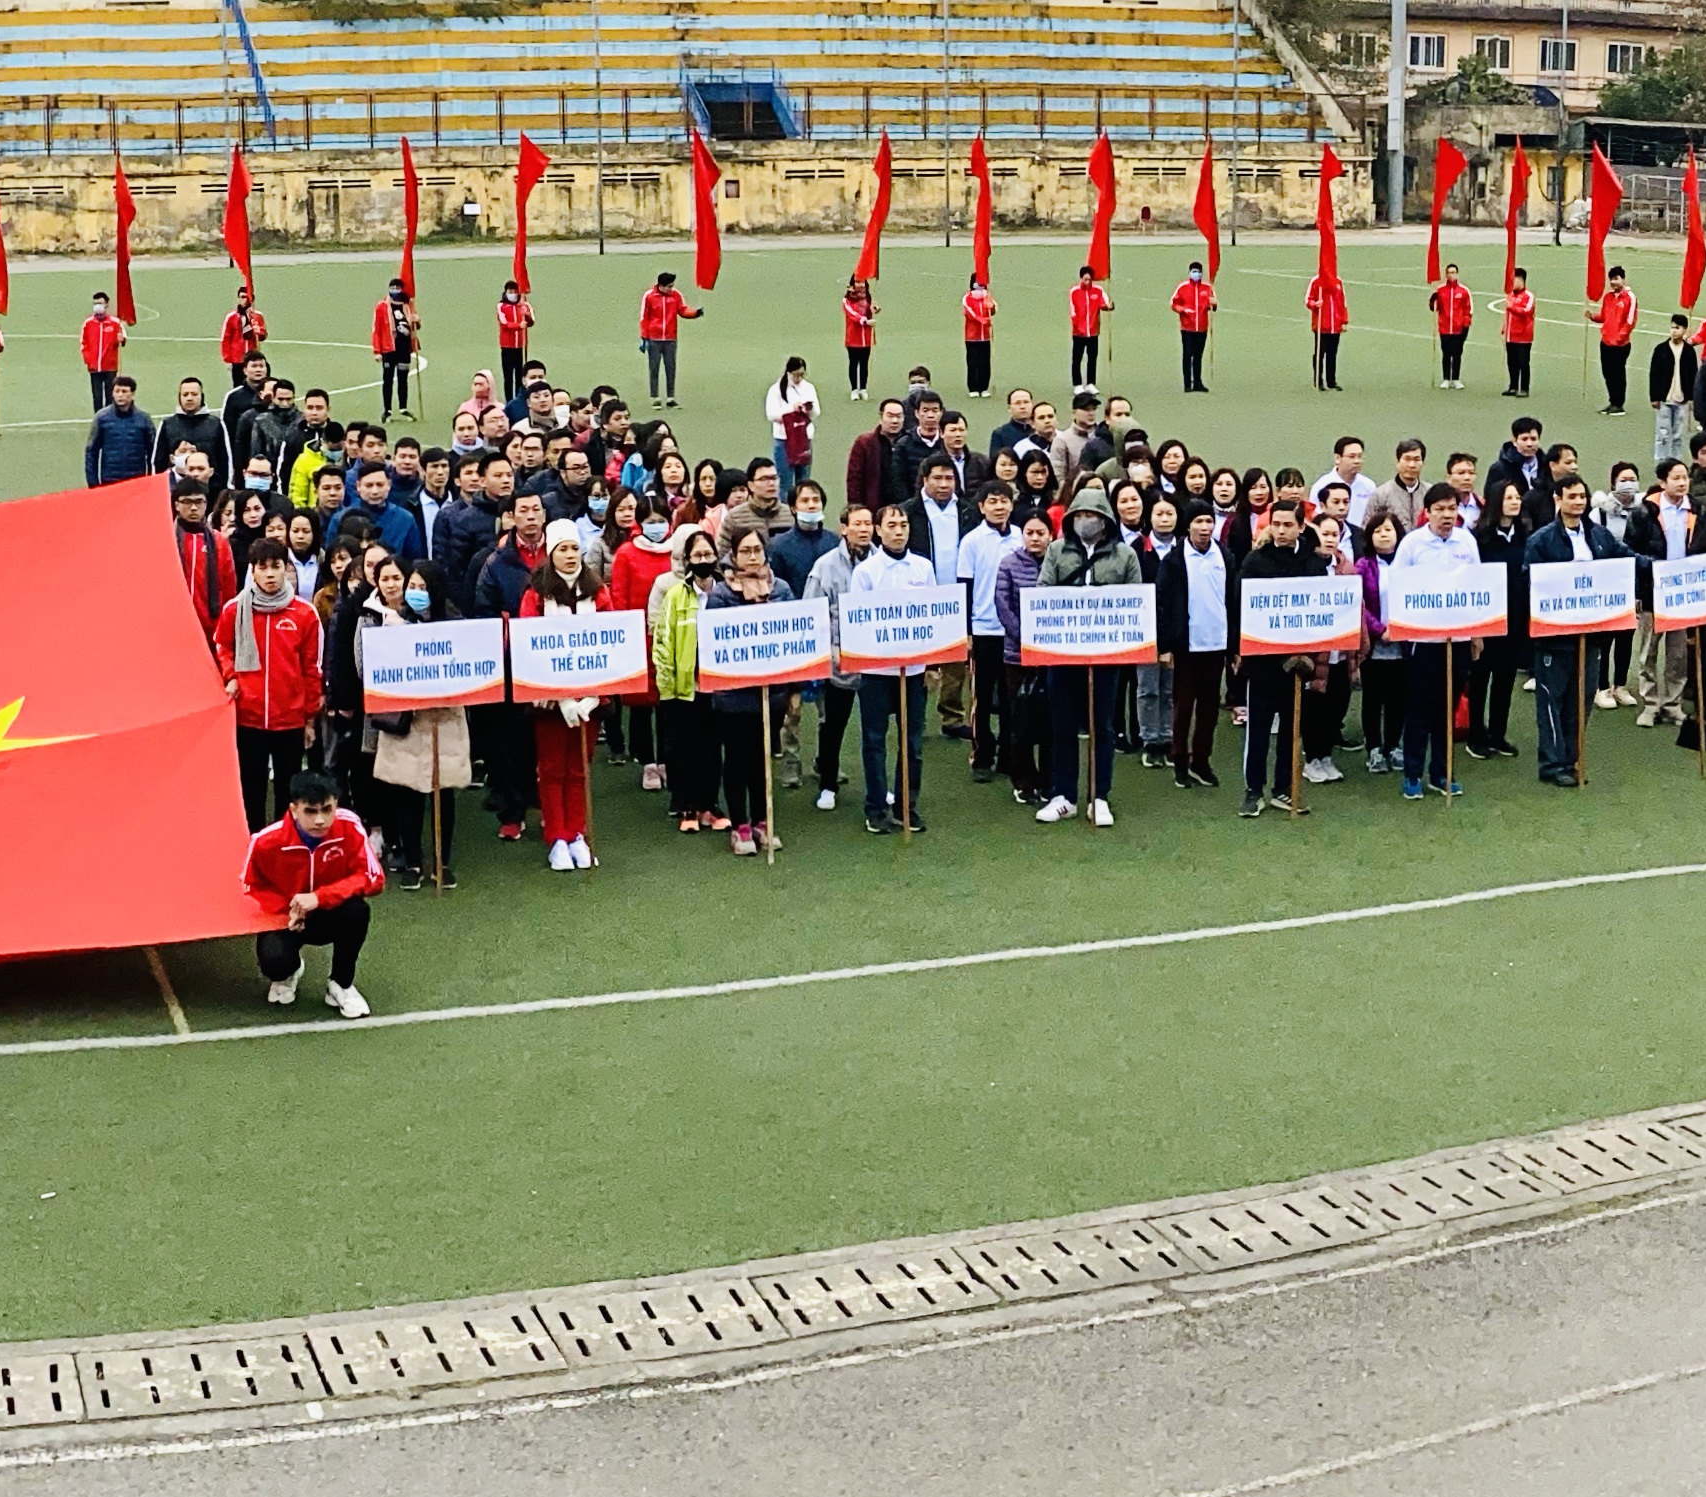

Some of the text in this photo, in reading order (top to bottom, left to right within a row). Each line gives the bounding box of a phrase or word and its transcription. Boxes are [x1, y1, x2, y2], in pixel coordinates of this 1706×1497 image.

[1574, 574, 1593, 592] VIỆN
[1250, 593, 1269, 610] VIỆN
[1272, 592, 1289, 610] DỆT
[1292, 593, 1310, 608] MAY
[1320, 592, 1332, 606] DA
[1405, 590, 1442, 610] PHÒNG
[1471, 591, 1490, 611] TẠO
[1540, 599, 1550, 612] KH
[1552, 596, 1563, 611] VÀ
[1566, 597, 1577, 610] CN
[848, 600, 959, 625] VIỆN TOÁN ỨNG DỤNG
[1269, 613, 1334, 629] VÀ THỜI TRANG
[531, 629, 626, 650] KHOA GIÁO DỤC
[714, 616, 814, 643] VIỆN CN SINH HỌC
[876, 625, 933, 644] VÀ TIN HỌC
[416, 638, 452, 657] PHÒNG
[715, 645, 729, 664] VÀ
[732, 646, 749, 661] CN
[751, 643, 780, 663] THỰC
[373, 658, 496, 684] HÀNH CHÍNH TỔNG HỢP
[578, 650, 608, 671] CHẤT
